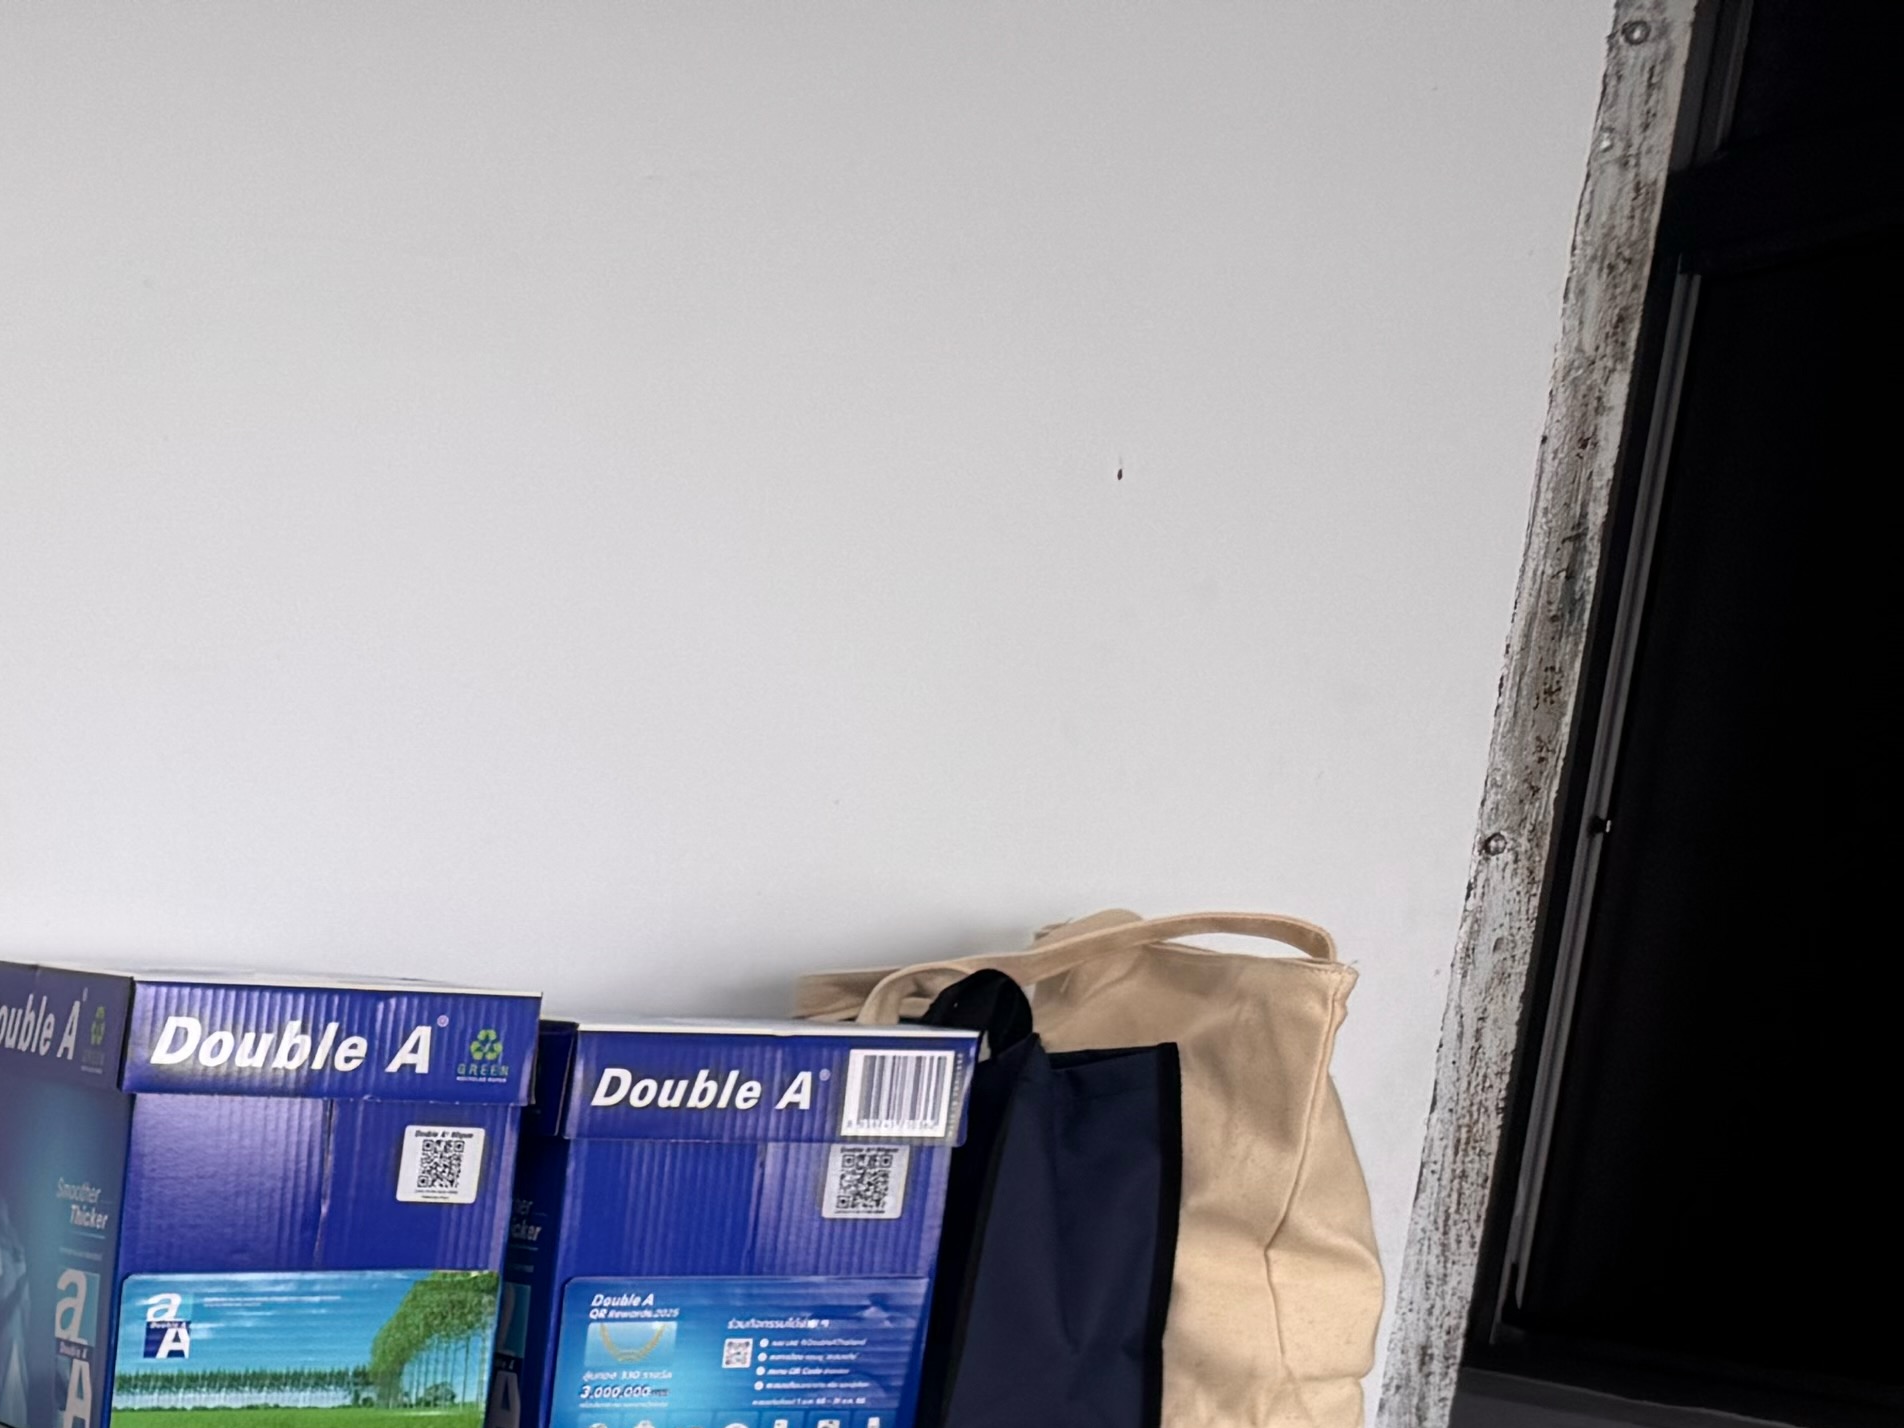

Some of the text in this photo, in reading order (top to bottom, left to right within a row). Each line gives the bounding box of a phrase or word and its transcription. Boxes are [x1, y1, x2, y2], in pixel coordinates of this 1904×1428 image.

[57, 994, 80, 1062] A
[151, 1016, 368, 1073] Double
[385, 1025, 433, 1075] A
[457, 1065, 510, 1077] GREEN
[591, 1067, 812, 1110] Double A
[57, 1177, 101, 1203] Smoother
[70, 1204, 108, 1230] Thicker
[589, 1308, 607, 1318] QR
[591, 1294, 654, 1306] Double A
